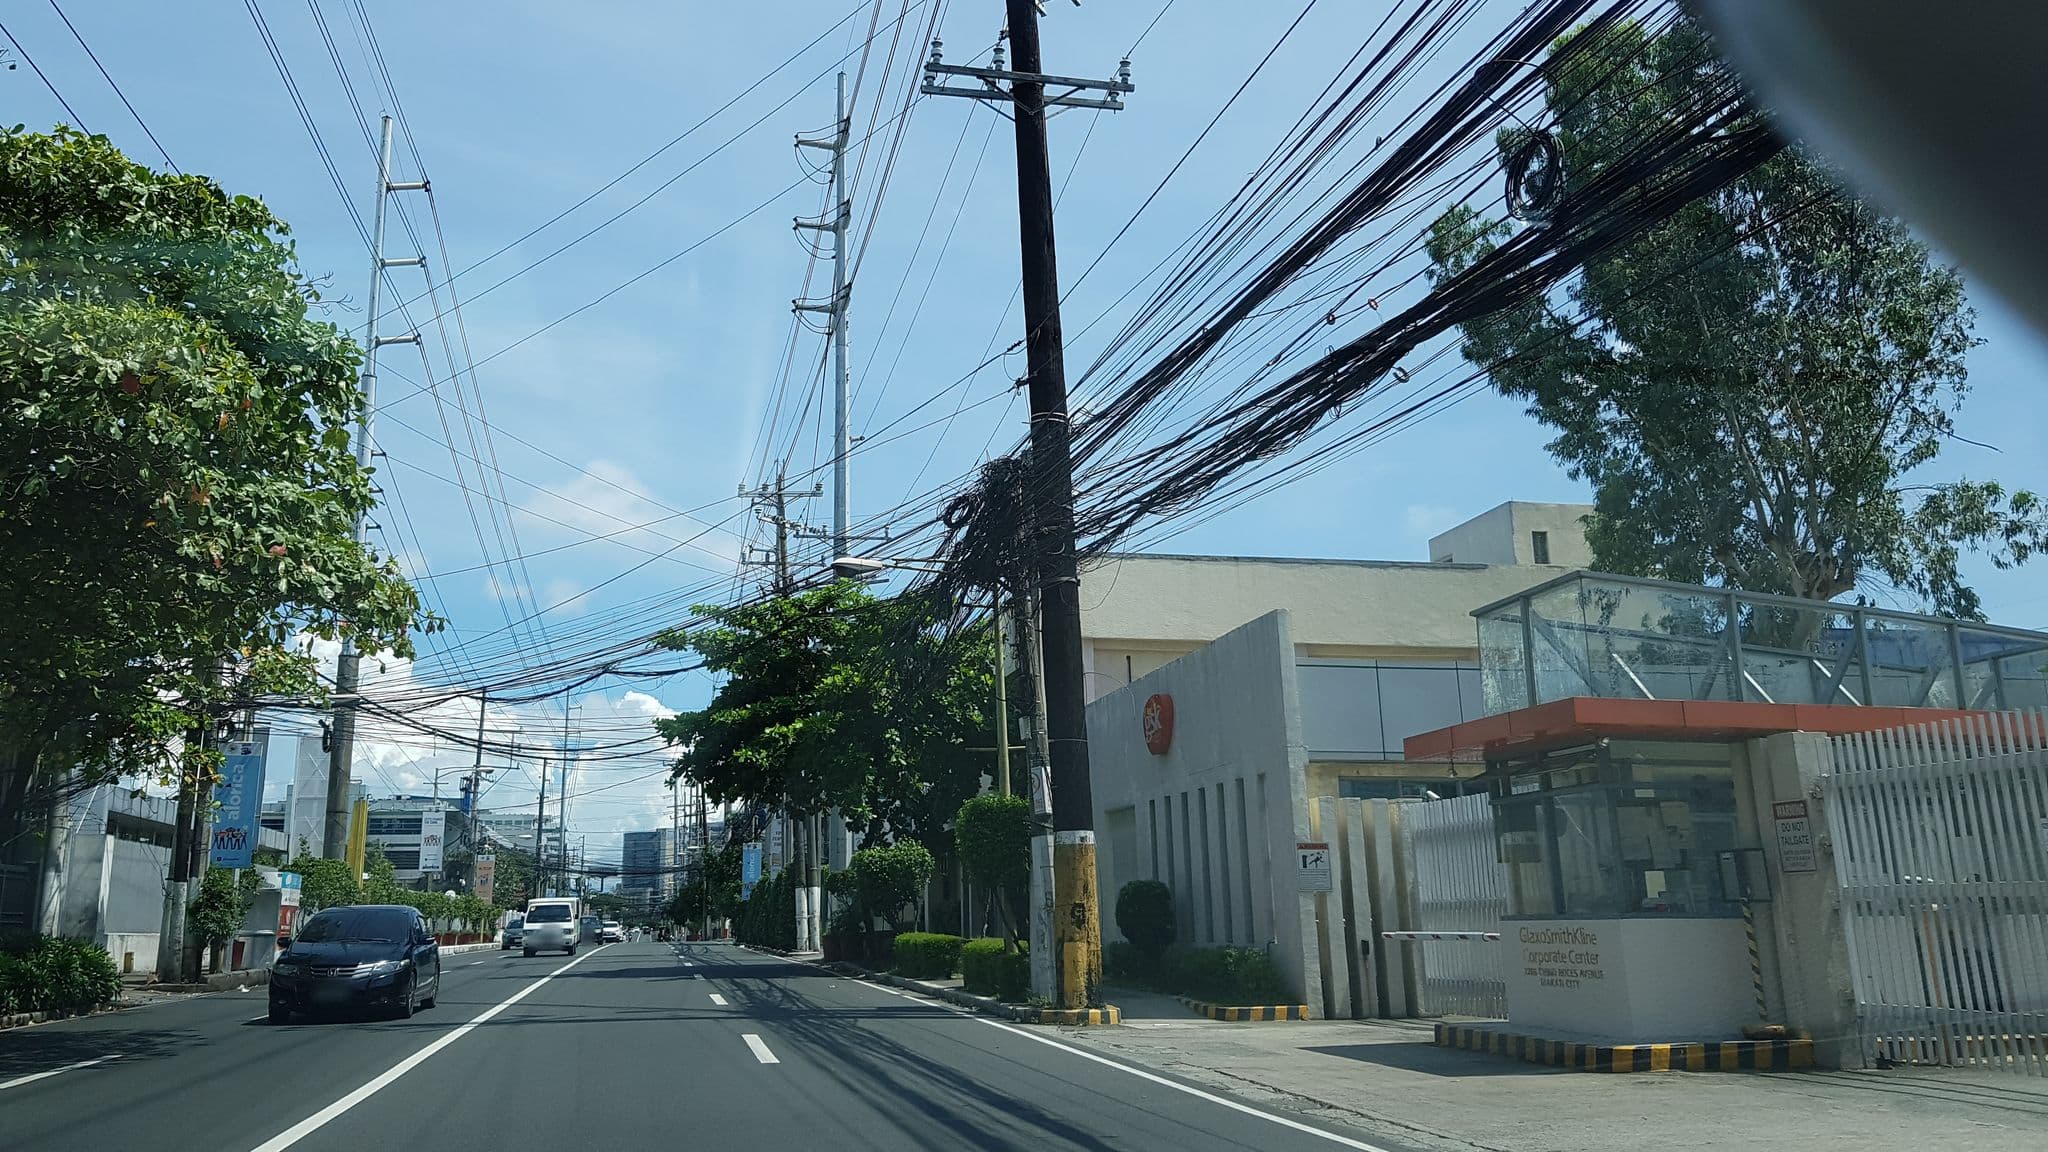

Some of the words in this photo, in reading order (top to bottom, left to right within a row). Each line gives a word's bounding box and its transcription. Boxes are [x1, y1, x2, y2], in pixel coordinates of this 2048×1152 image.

[1145, 702, 1162, 743] gsk
[224, 763, 245, 820] alorica
[1520, 927, 1597, 945] GlaxoSmithKline
[1568, 950, 1599, 965] Center
